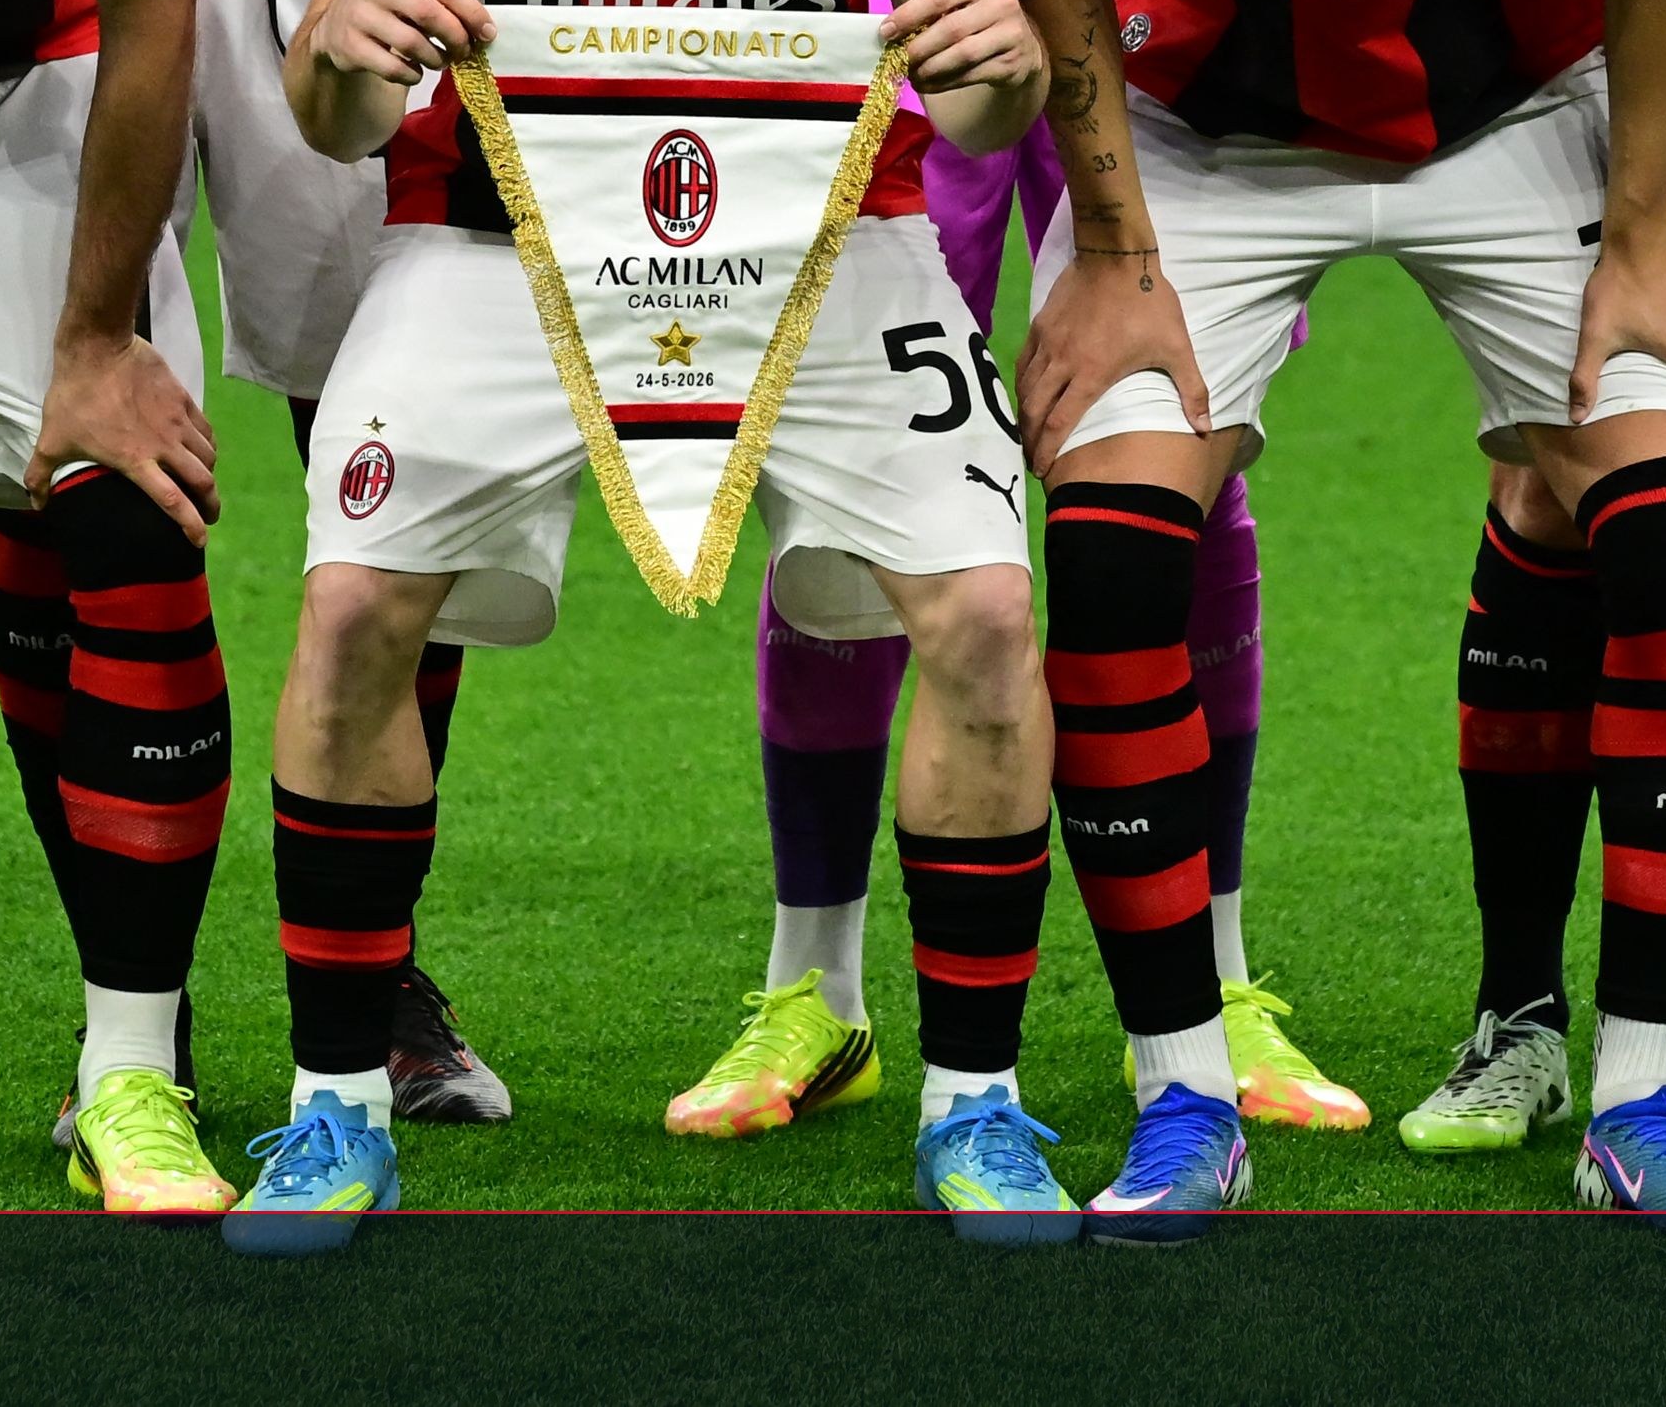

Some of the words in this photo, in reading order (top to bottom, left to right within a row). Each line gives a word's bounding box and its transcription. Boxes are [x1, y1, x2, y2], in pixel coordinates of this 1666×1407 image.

[549, 25, 819, 60] CAMPIONATO
[661, 141, 700, 162] ACM
[1092, 152, 1118, 173] 33
[663, 219, 696, 232] 1899
[595, 257, 640, 286] AC
[648, 257, 763, 286] MILAN
[628, 294, 728, 309] CAGLIARI
[636, 372, 715, 388] 24-5-2026
[882, 320, 1025, 446] 56
[356, 449, 385, 464] ACM
[349, 499, 373, 511] 1899
[133, 730, 223, 762] MILAN
